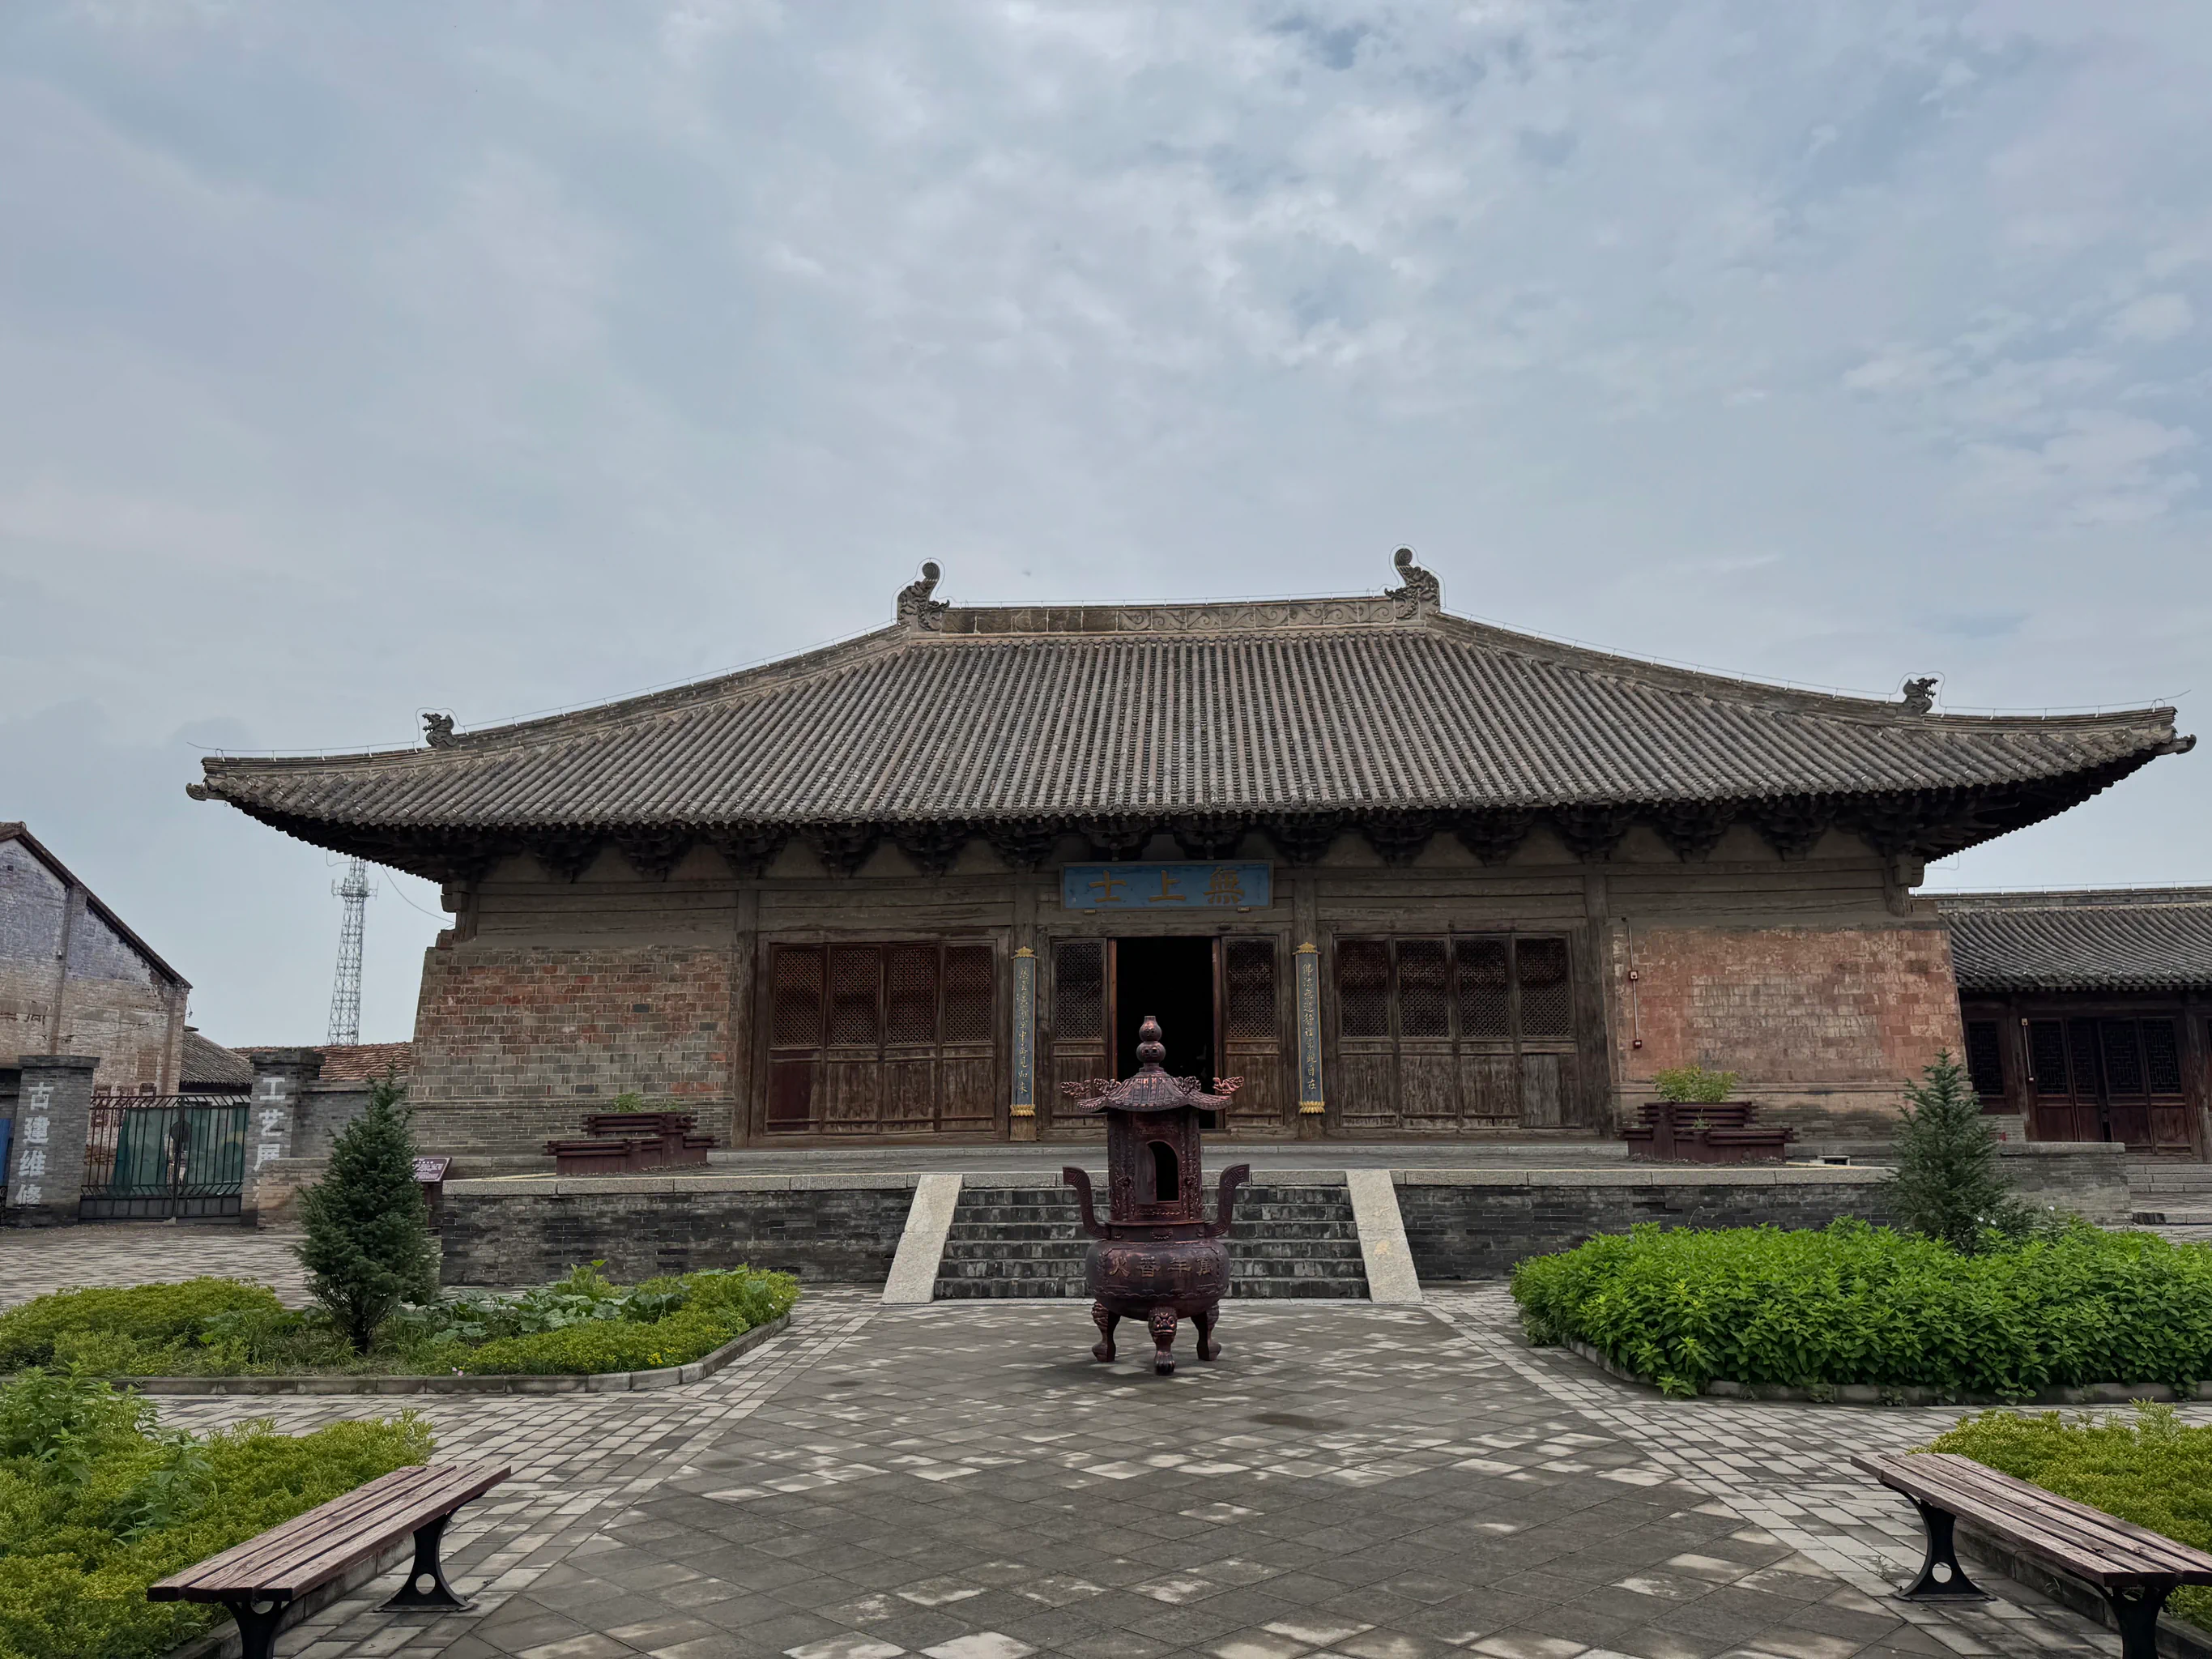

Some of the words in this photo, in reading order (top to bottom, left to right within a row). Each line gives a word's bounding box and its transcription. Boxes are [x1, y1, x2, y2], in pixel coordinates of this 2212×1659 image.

[17, 1082, 54, 1207] 古建维修
[254, 1077, 287, 1202] 工艺展
